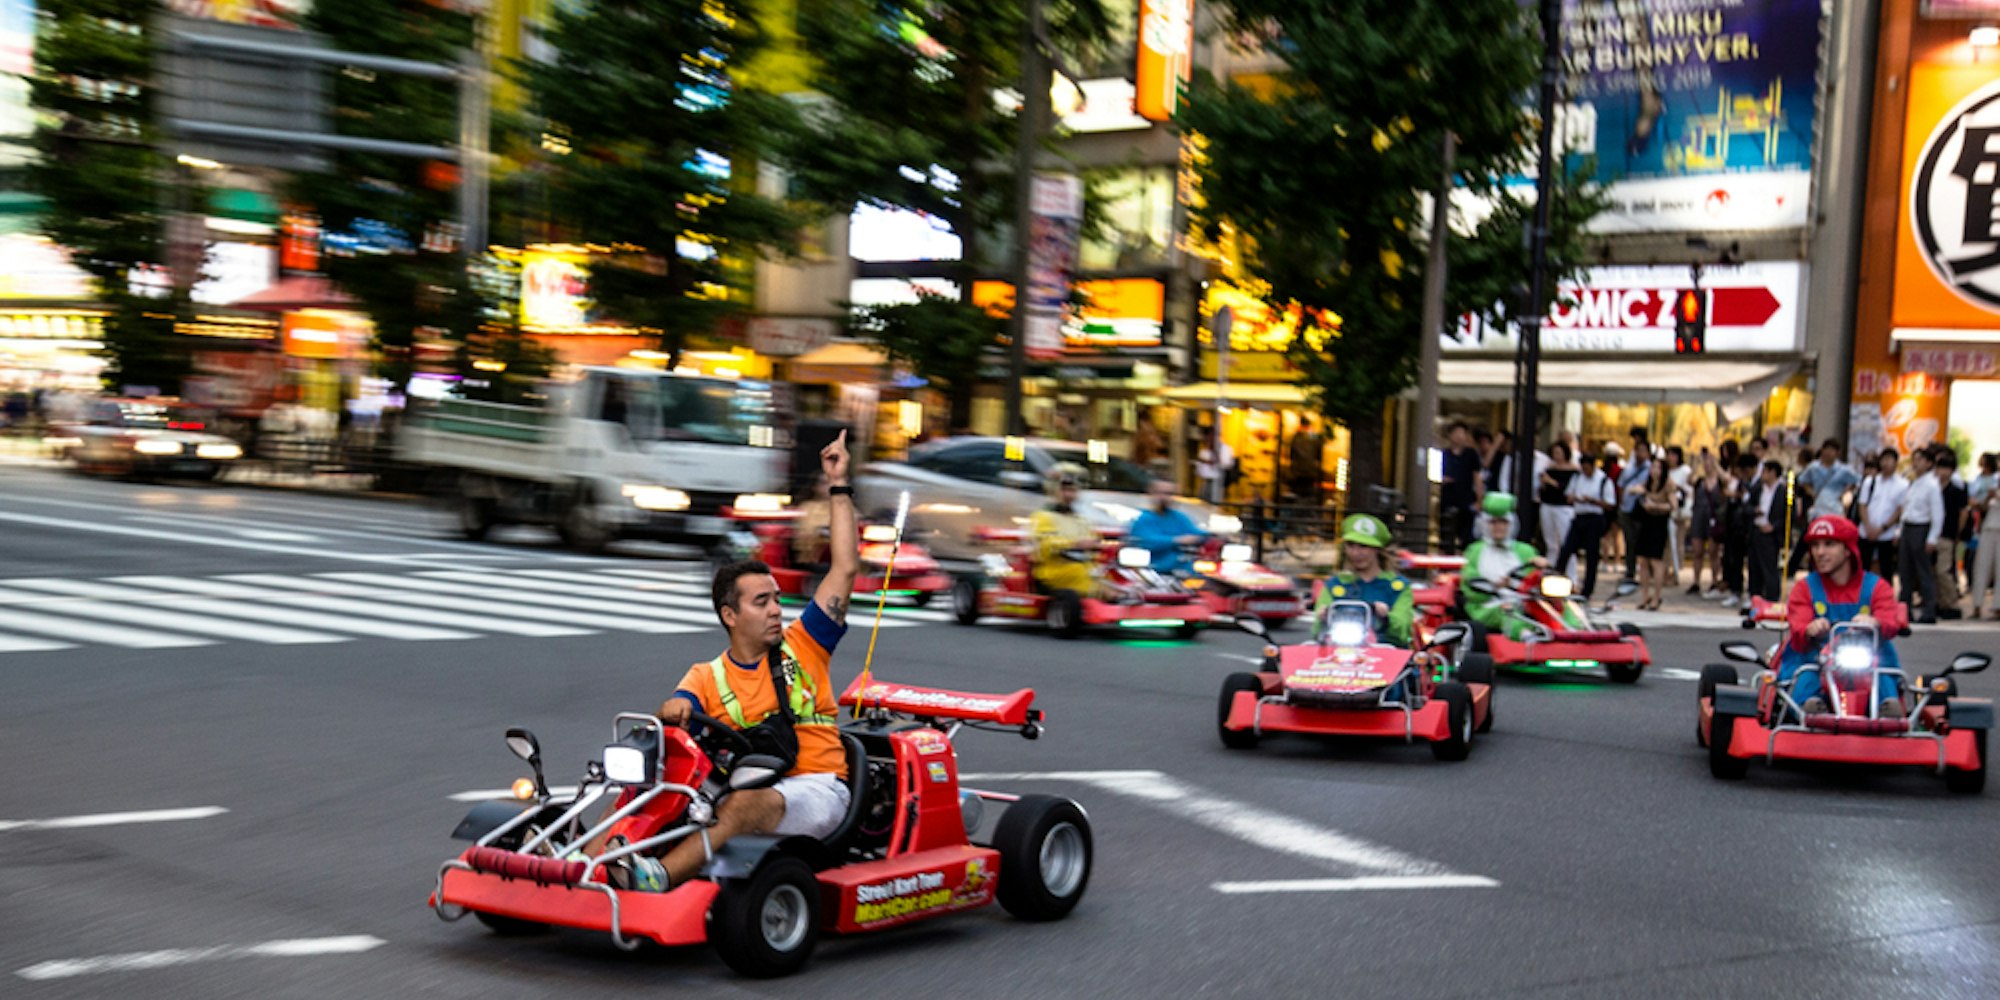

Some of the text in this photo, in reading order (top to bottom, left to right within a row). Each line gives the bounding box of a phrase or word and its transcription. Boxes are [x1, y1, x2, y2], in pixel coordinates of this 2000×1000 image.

[1652, 9, 1722, 38] MIKU
[1595, 40, 1690, 71] BUNNY
[1549, 289, 1650, 327] OMIC
[856, 881, 896, 904] Street
[917, 870, 945, 890] Tour
